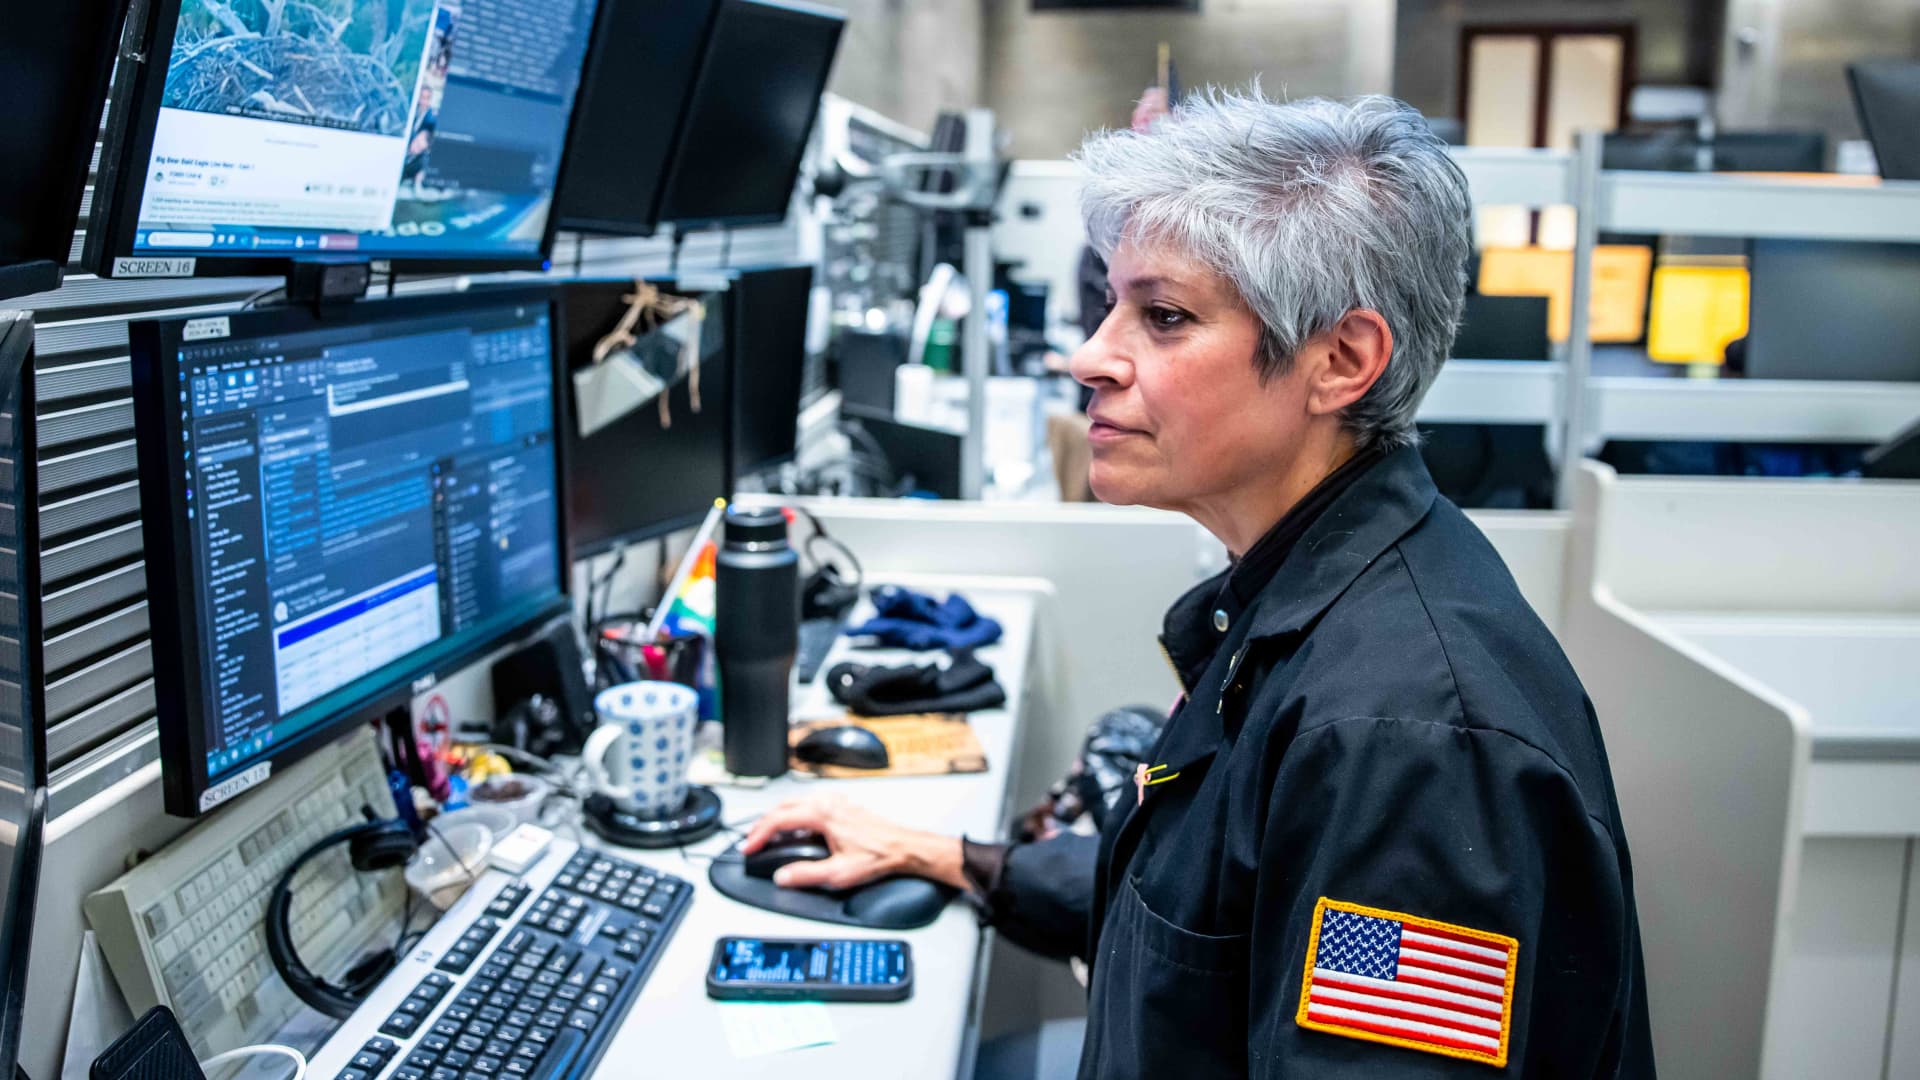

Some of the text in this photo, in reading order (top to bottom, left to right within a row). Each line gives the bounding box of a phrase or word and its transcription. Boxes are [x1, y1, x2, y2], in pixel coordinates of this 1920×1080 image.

[156, 155, 165, 164] Big
[118, 260, 191, 274] SCREEN 16
[204, 774, 251, 806] SCREEN
